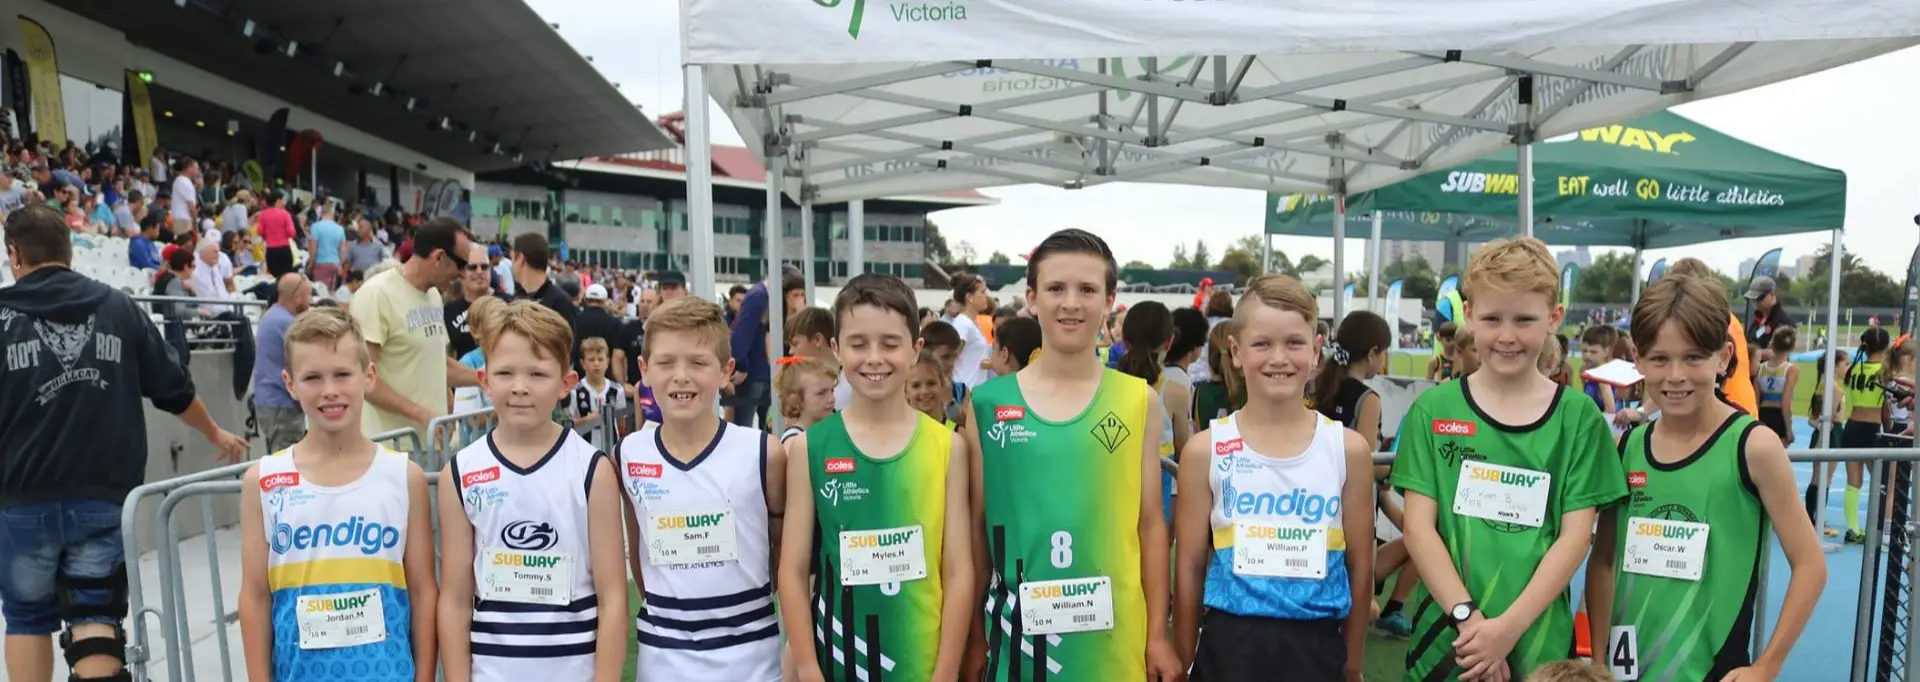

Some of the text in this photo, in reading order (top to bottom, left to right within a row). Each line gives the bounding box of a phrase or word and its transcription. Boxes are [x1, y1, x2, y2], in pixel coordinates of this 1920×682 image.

[890, 1, 967, 22] Victoria
[1544, 124, 1697, 153] WAY
[1440, 171, 1520, 194] SUBWA
[1558, 175, 1784, 206] EAT well GO little athletics
[7, 332, 122, 371] HOT ROD
[1767, 376, 1775, 390] 2
[997, 408, 1023, 418] coles
[1107, 417, 1117, 428] D
[1438, 422, 1469, 433] coles
[630, 465, 657, 476] coles
[827, 461, 853, 470] coles
[265, 475, 294, 488] coles
[467, 471, 495, 484] coles
[1470, 467, 1540, 488] SUBWAY
[1222, 477, 1341, 524] bendigo
[656, 513, 724, 530] SUBWAY
[271, 512, 400, 555] bendigo
[684, 531, 710, 540] Sam.F
[849, 530, 914, 548] SUBWAY
[1245, 525, 1317, 541] SUBWAY
[1635, 523, 1699, 540] SUBWAY
[872, 551, 905, 560] Myles.H
[1051, 531, 1073, 569] 8
[1266, 543, 1308, 552] William.P
[1653, 543, 1686, 553] Oscar.W
[493, 552, 561, 568] SUBWAY
[514, 572, 552, 581] Tommy.S
[1031, 581, 1101, 599] SUBWAY
[306, 594, 371, 612] SUBWAY
[1052, 600, 1093, 610] William.N
[327, 611, 364, 622] Jordan.M
[1613, 631, 1634, 675] 4
